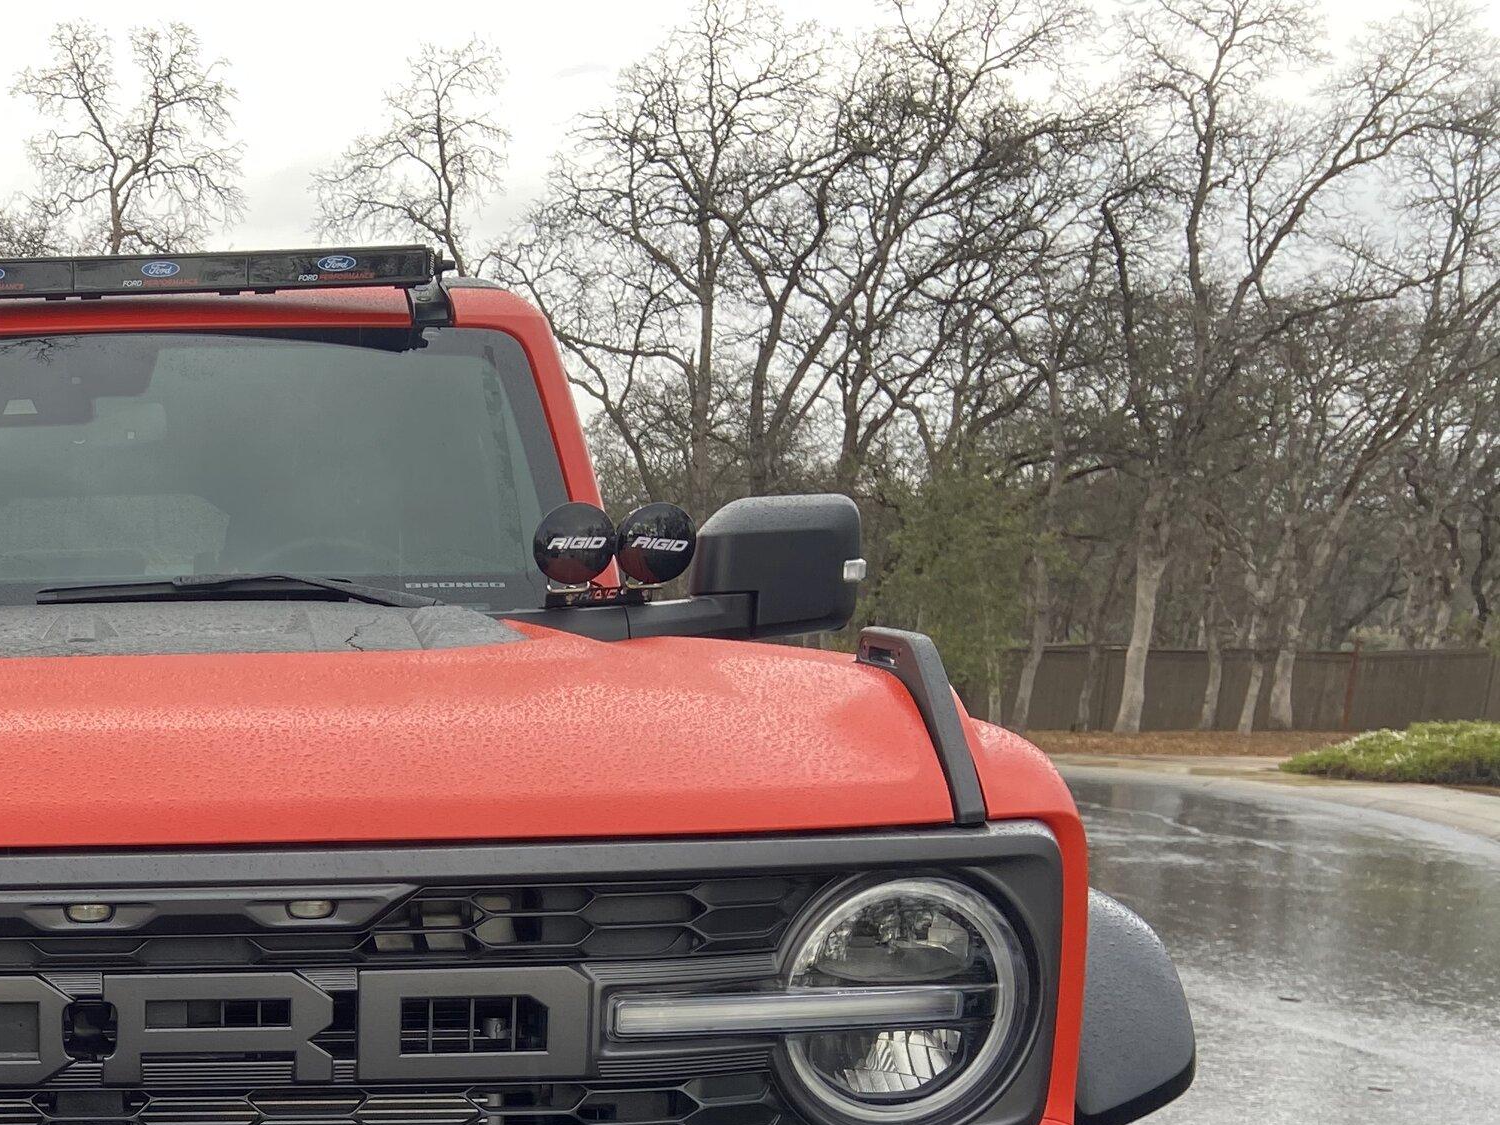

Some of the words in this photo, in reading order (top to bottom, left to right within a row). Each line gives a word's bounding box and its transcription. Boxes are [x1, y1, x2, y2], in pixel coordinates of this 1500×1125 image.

[298, 274, 318, 282] FORD
[547, 536, 607, 550] RIGID
[631, 536, 688, 552] RIGID
